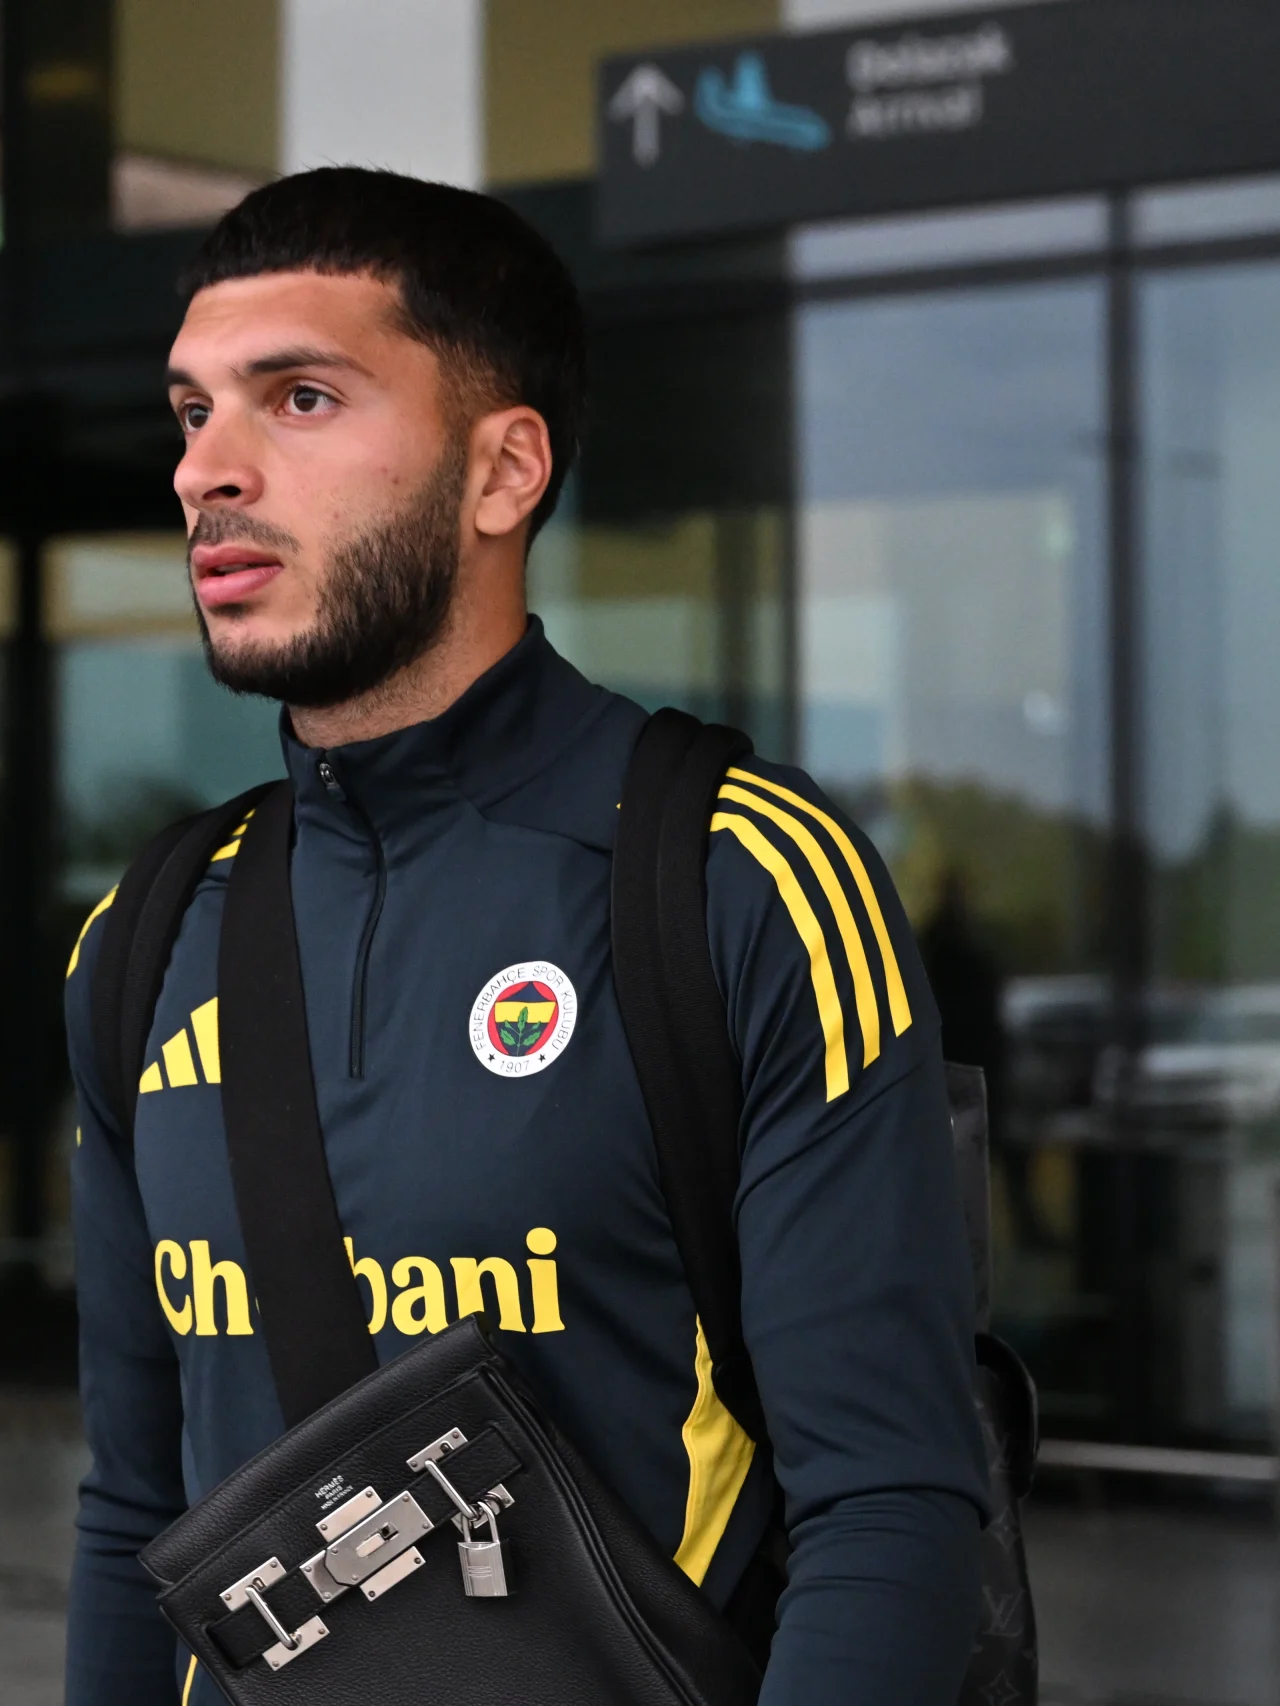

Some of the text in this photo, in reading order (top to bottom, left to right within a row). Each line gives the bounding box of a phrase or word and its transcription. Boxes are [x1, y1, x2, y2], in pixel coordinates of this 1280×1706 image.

[473, 966, 526, 1051] FENERBAHÇE
[532, 965, 564, 988] SPOR
[499, 1059, 530, 1074] 1907
[154, 1226, 566, 1336] Chbani
